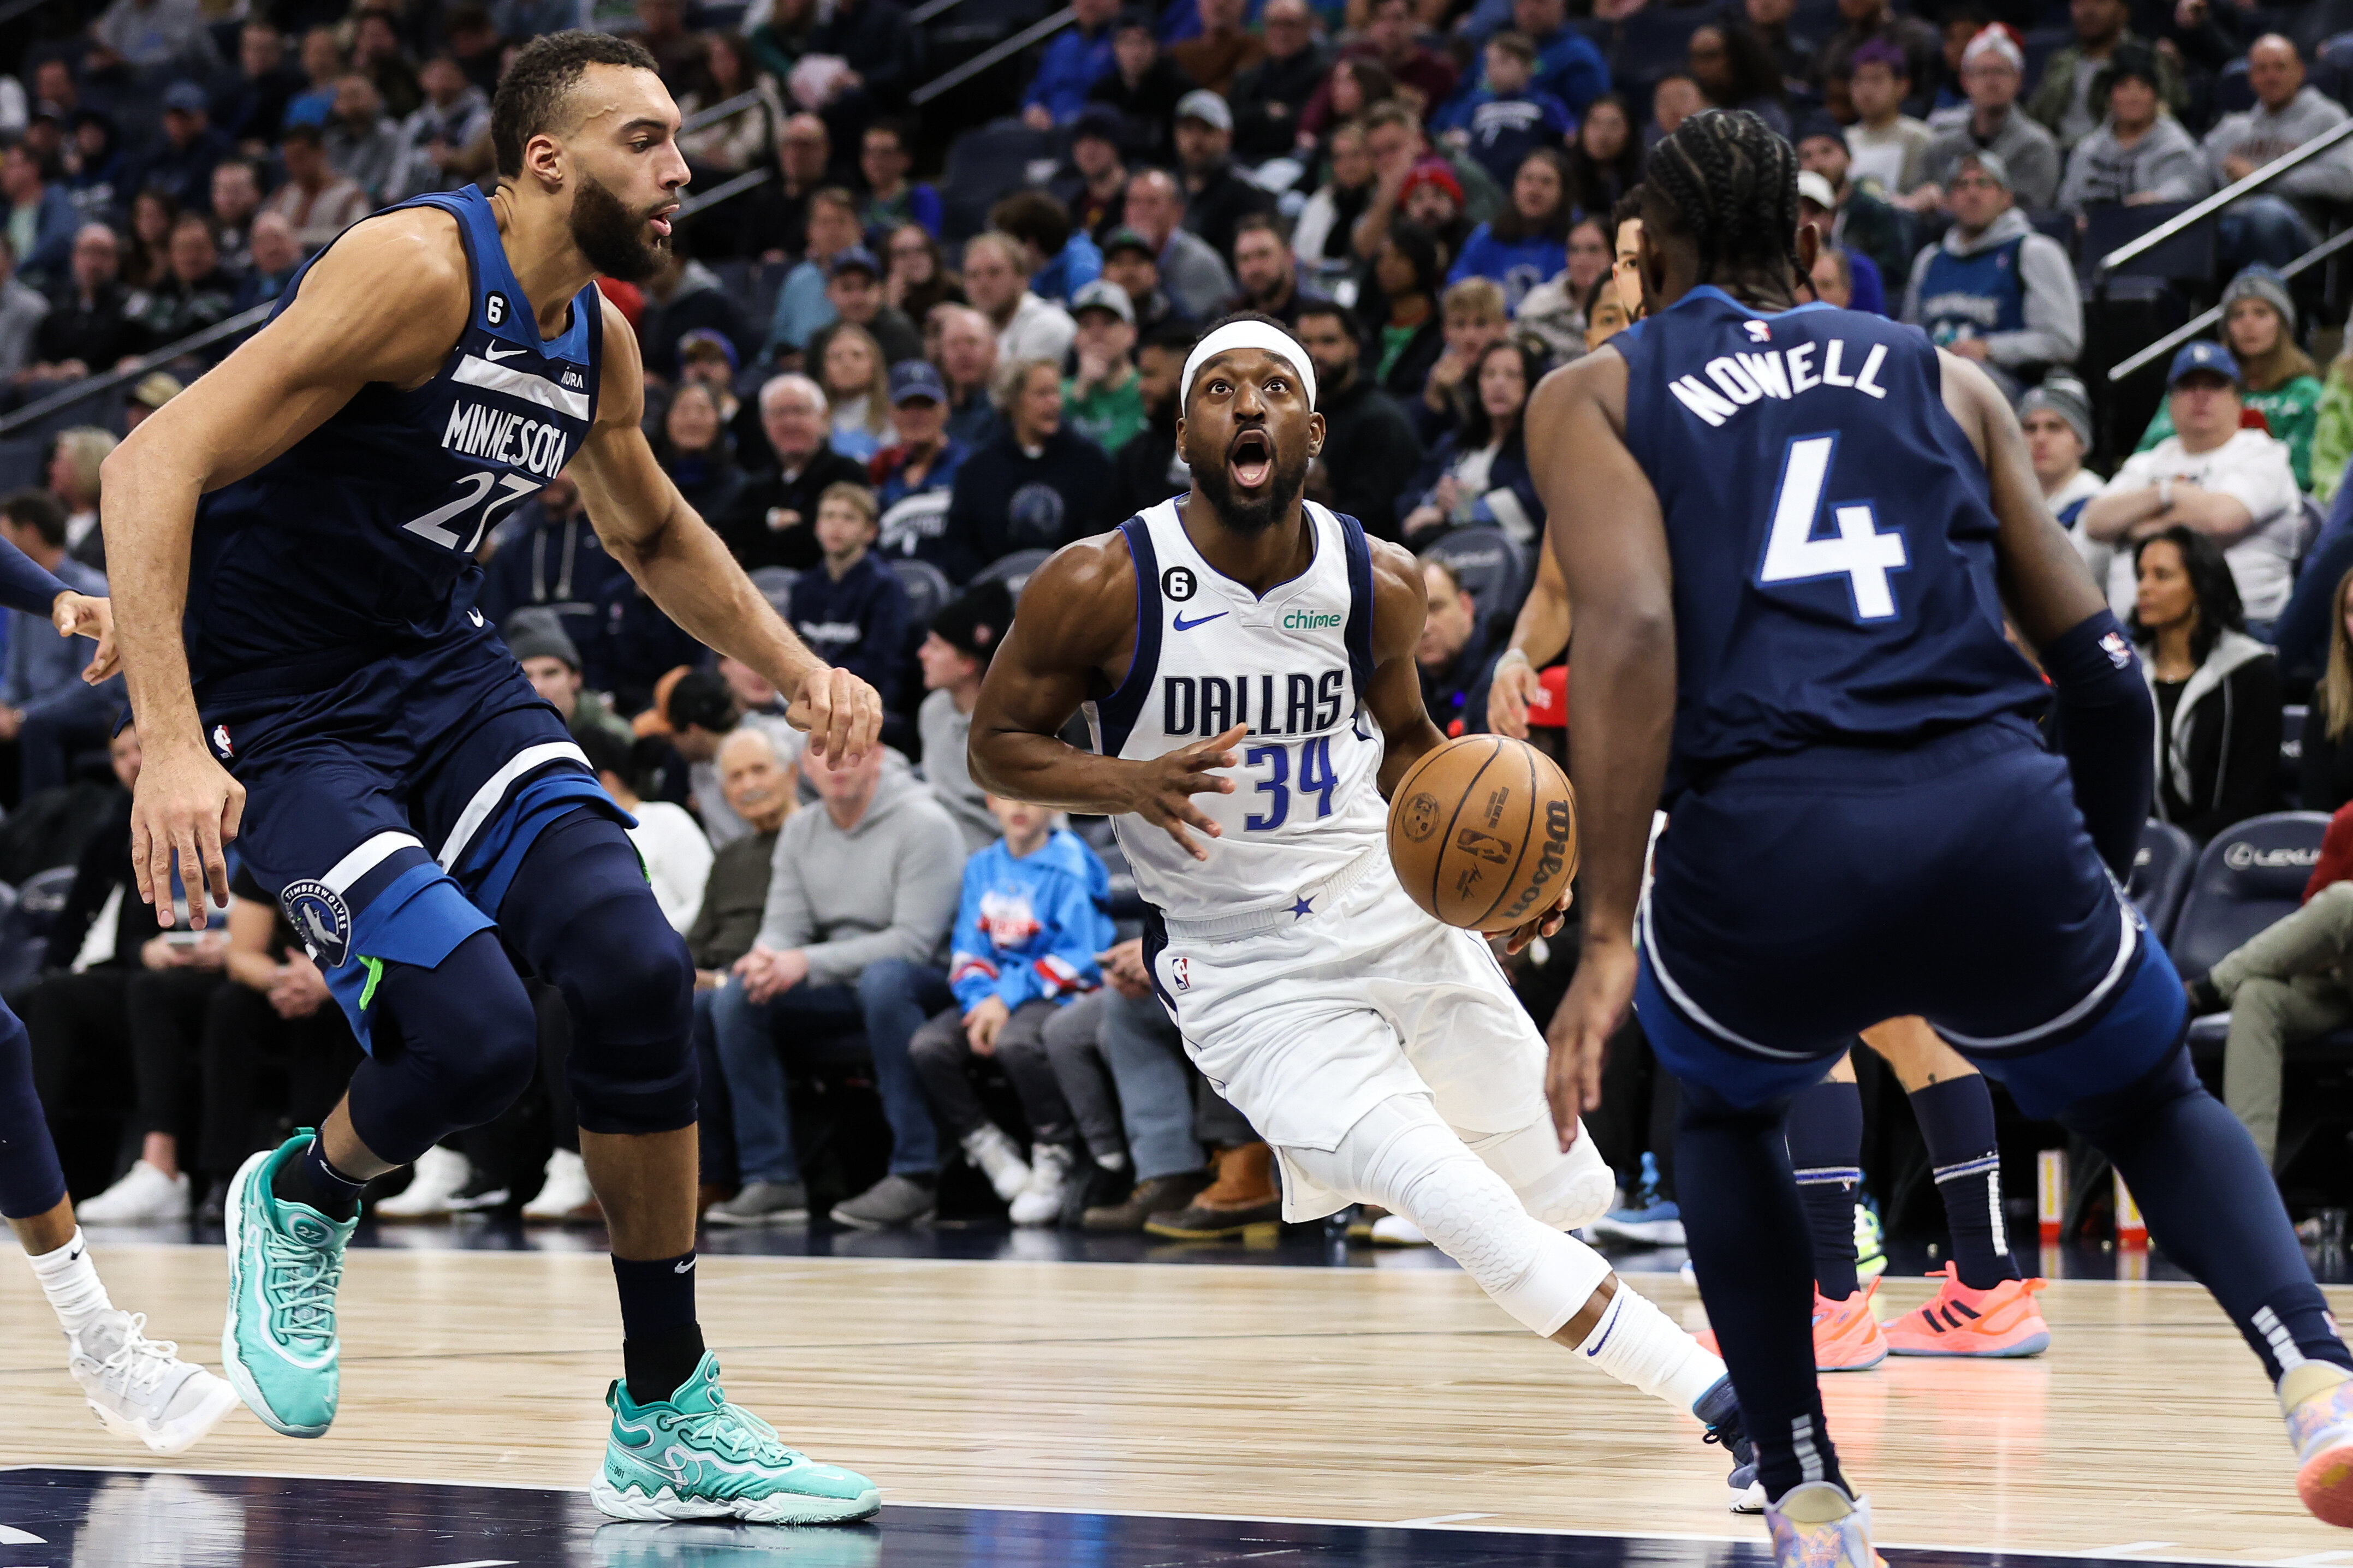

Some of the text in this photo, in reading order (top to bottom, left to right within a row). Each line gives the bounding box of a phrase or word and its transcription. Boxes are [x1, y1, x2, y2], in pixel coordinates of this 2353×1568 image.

[488, 295, 504, 324] 6
[1668, 338, 1889, 427] NOWELL
[401, 471, 543, 553] 27
[1754, 430, 1912, 625] 4
[1169, 571, 1189, 598] 6
[1283, 609, 1341, 629] chime
[1162, 668, 1345, 737] DALLAS
[1244, 736, 1339, 832] 34
[285, 884, 347, 930] TIMBERWOLVES
[614, 1466, 625, 1479] 001
